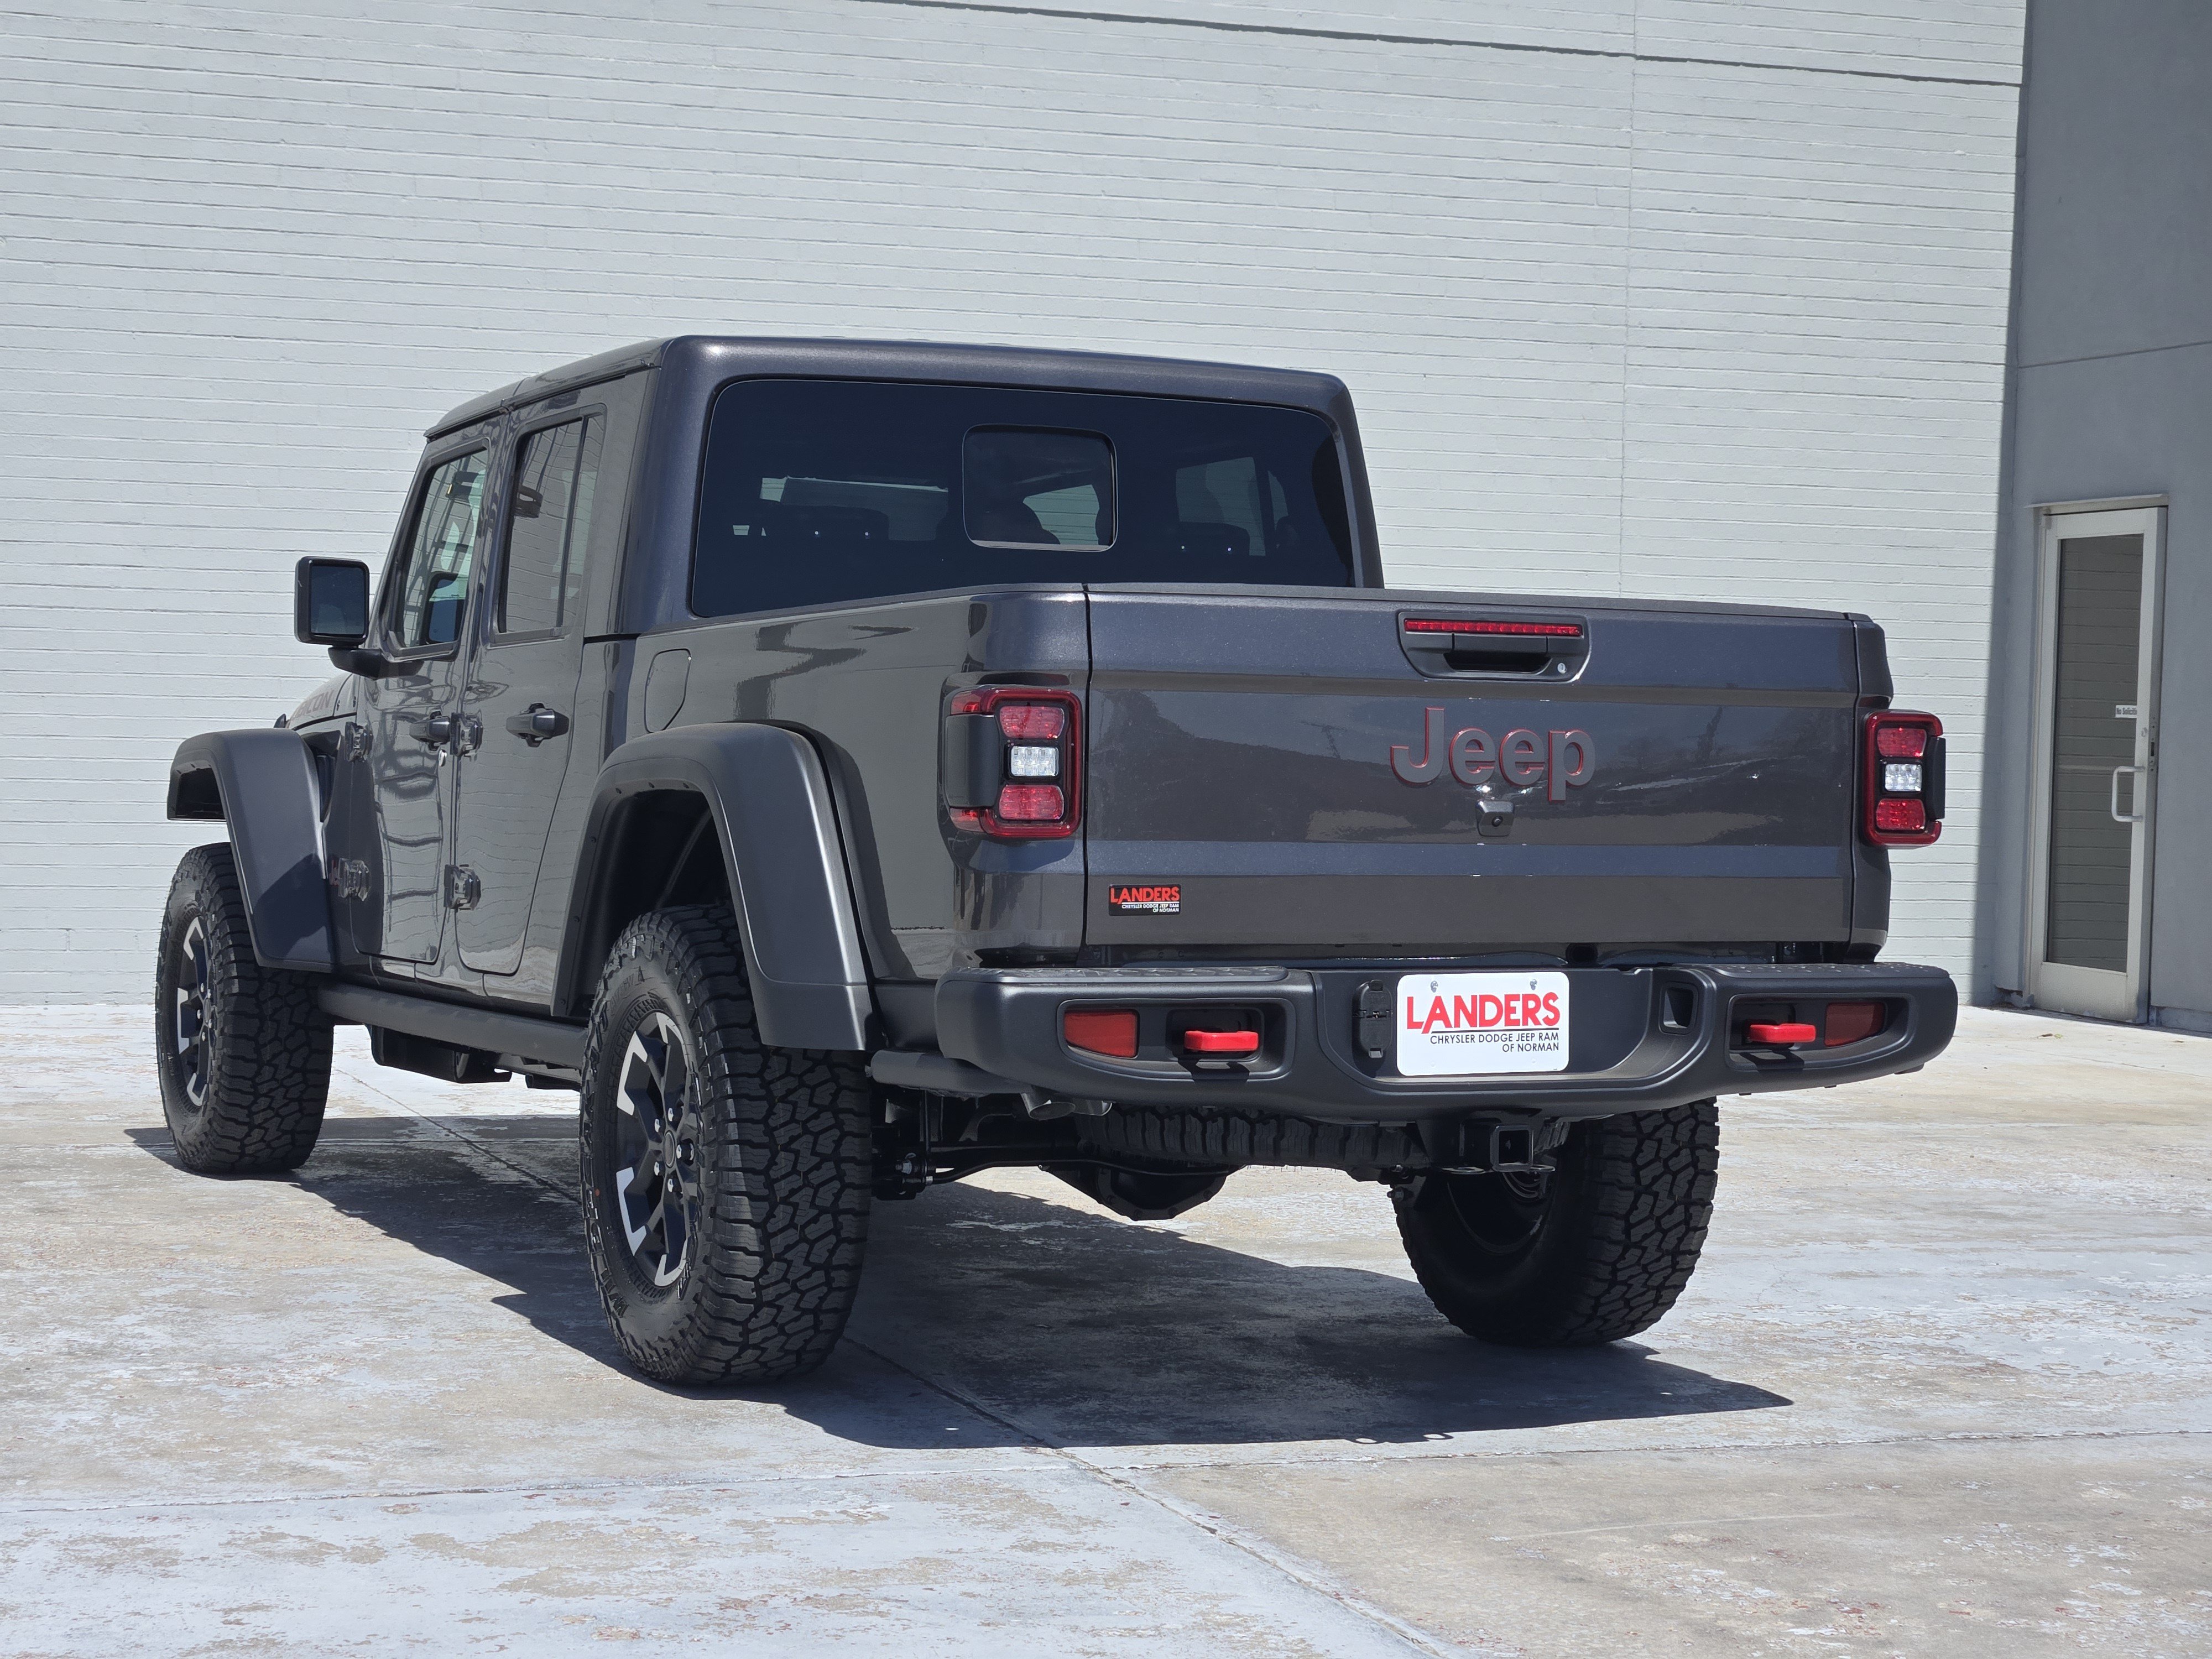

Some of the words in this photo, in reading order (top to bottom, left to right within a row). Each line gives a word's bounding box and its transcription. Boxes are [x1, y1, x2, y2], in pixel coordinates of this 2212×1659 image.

[1390, 707, 1596, 804] Jeep
[1110, 886, 1180, 904] LANDERS
[1407, 992, 1560, 1034] LANDERS
[1430, 1034, 1475, 1044] CHRYSLER
[1479, 1033, 1513, 1043] DODGE
[1516, 1032, 1535, 1042] JEEP
[1538, 1032, 1559, 1041] RAM
[1502, 1044, 1515, 1052] OF
[1517, 1042, 1559, 1052] NORMAN
